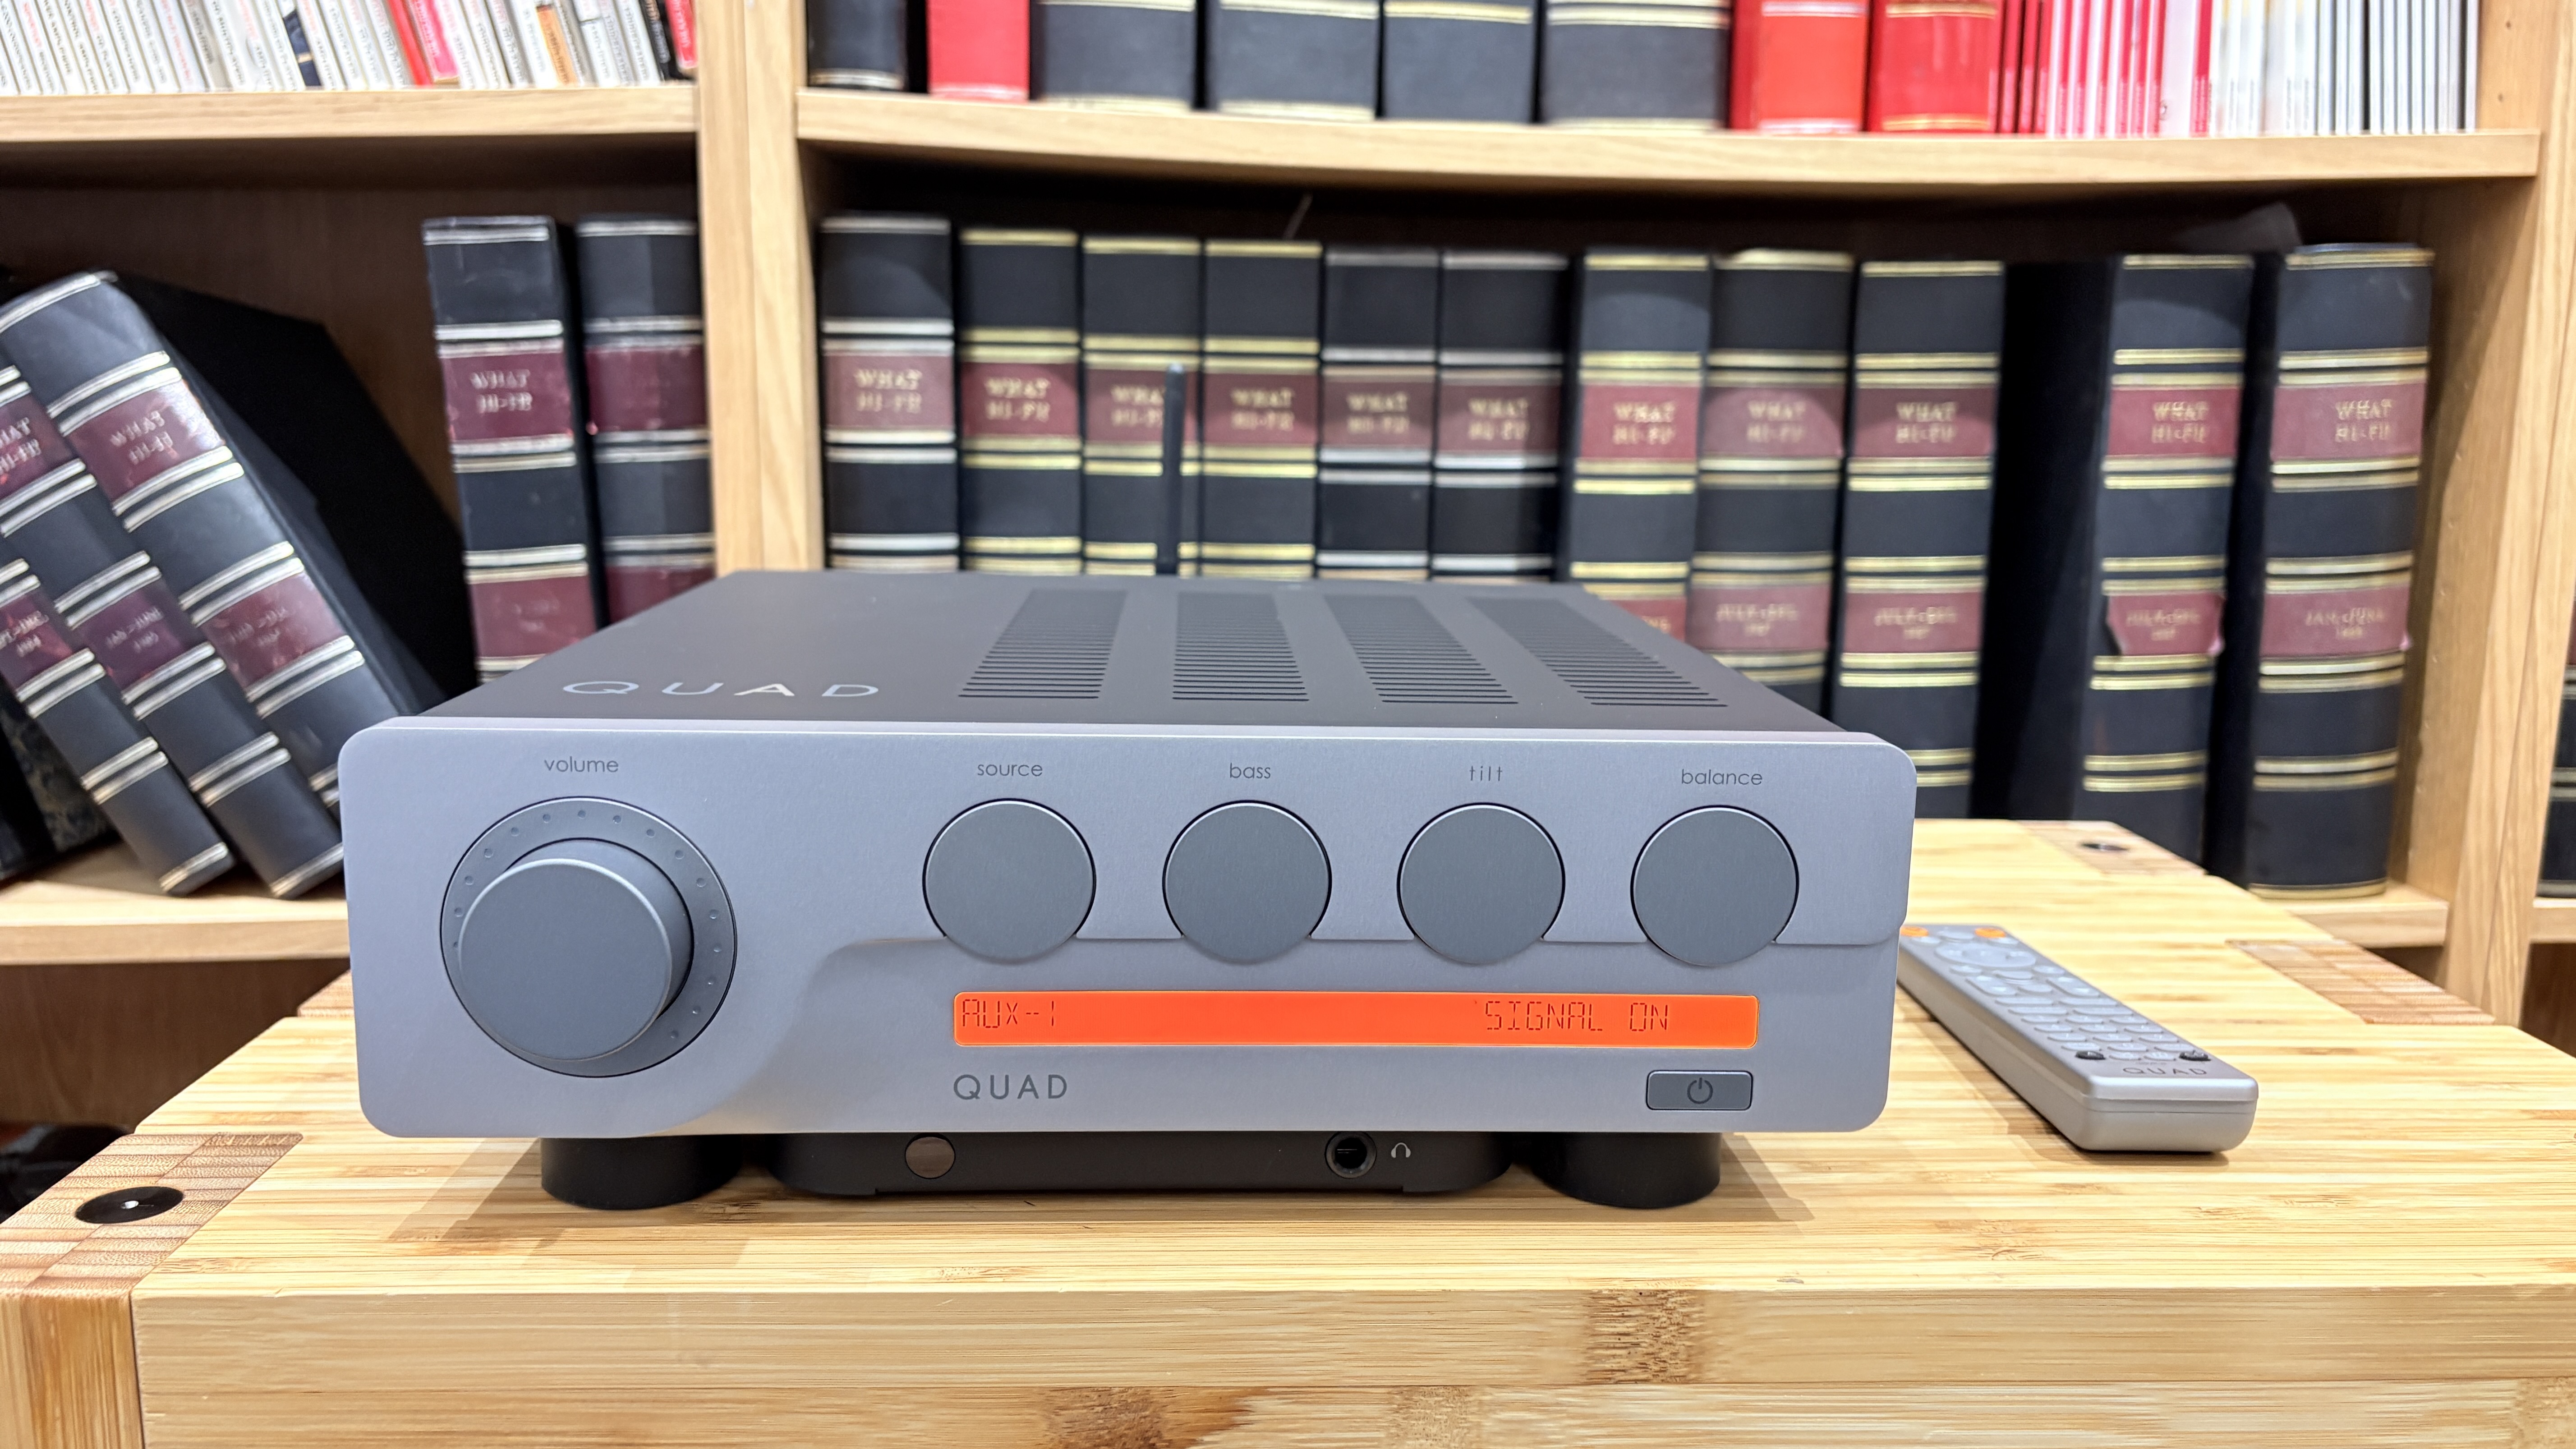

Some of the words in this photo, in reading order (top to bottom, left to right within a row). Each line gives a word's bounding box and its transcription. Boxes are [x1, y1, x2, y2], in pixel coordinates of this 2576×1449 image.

[470, 369, 530, 389] WHAT
[855, 368, 923, 391] WHAT
[985, 377, 1051, 400] WHAT
[1110, 385, 1165, 405] WHA
[1231, 387, 1295, 409] WHAT
[1347, 391, 1408, 413] WHAT
[1468, 397, 1529, 418] WHAT
[1614, 401, 1675, 422] WHAT
[1748, 400, 1805, 420] WHAT
[1897, 401, 1957, 422] WHAT
[2152, 402, 2208, 421] WHAT
[2336, 399, 2394, 419] WHAT
[110, 411, 165, 446] WHAT
[563, 681, 879, 697] QUAD
[544, 756, 619, 774] volume
[977, 762, 1043, 777] source
[1229, 762, 1271, 779] bass
[1469, 765, 1503, 782] tilt
[1681, 768, 1763, 786] balance
[1485, 1001, 1603, 1031] SIGNAL
[1629, 1002, 1668, 1032] ON
[2122, 1067, 2207, 1075] QUAD
[953, 1074, 1067, 1100] QUAD
